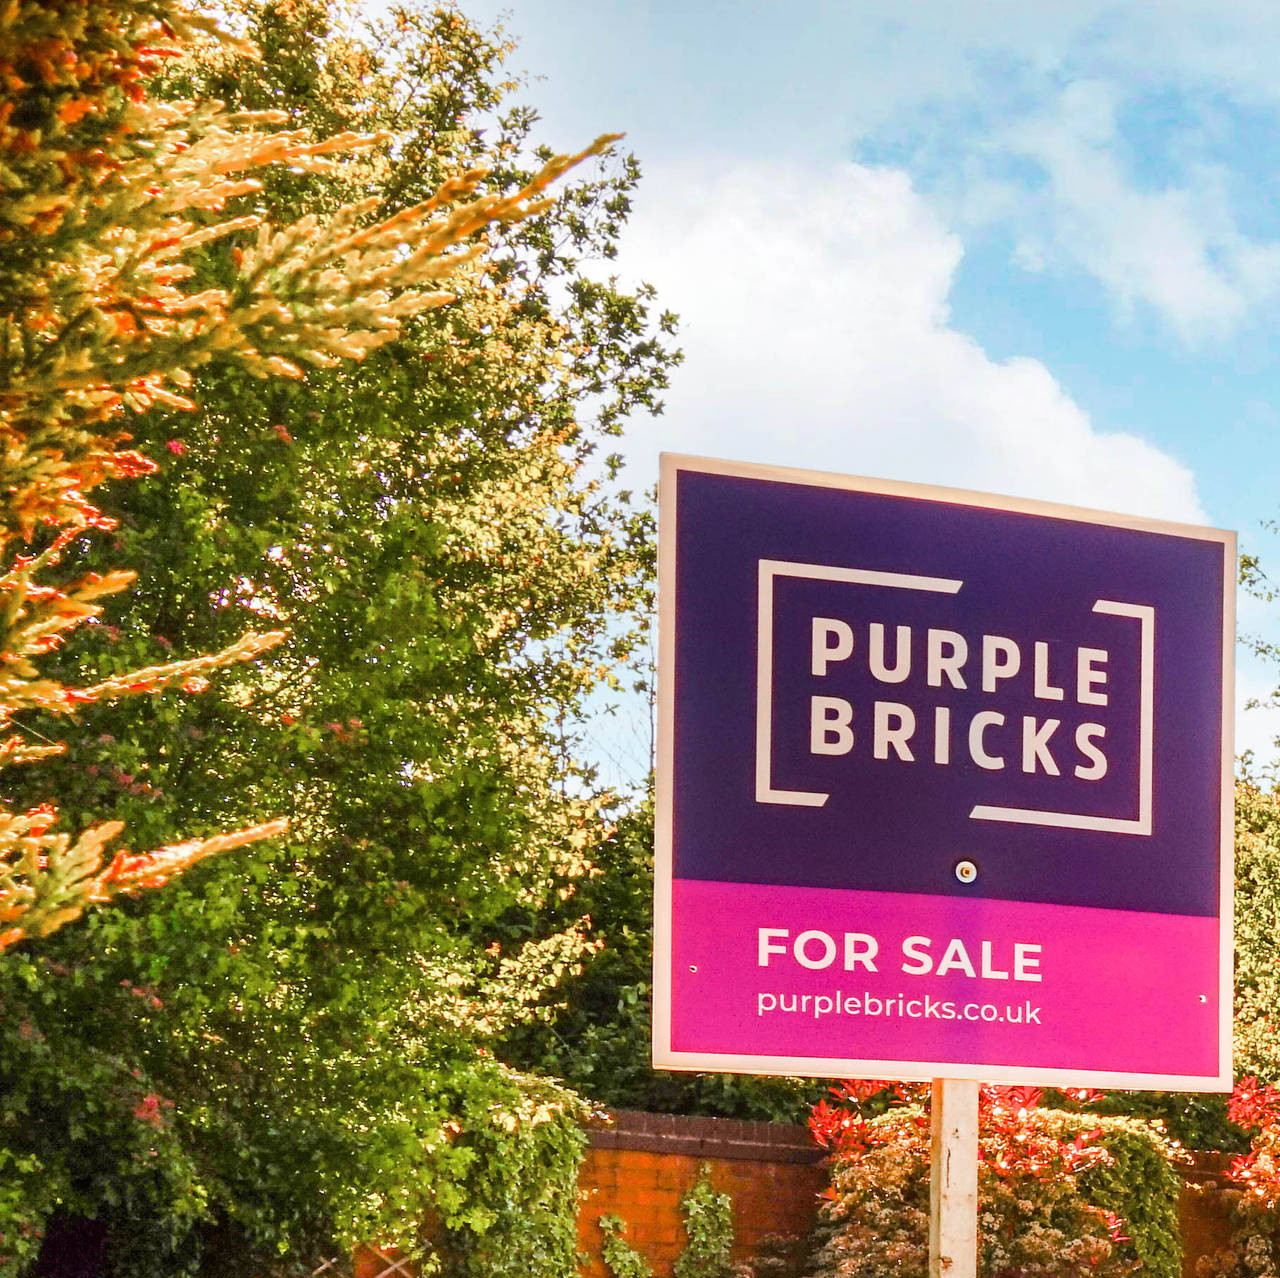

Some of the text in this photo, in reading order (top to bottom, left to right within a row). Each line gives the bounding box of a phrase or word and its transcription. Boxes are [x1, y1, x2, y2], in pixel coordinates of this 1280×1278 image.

[811, 616, 1109, 707] PURPLE
[810, 695, 1109, 782] BRICKS
[757, 927, 1044, 984] FOR SALE
[757, 990, 1043, 1026] purplebricks.co.uk
